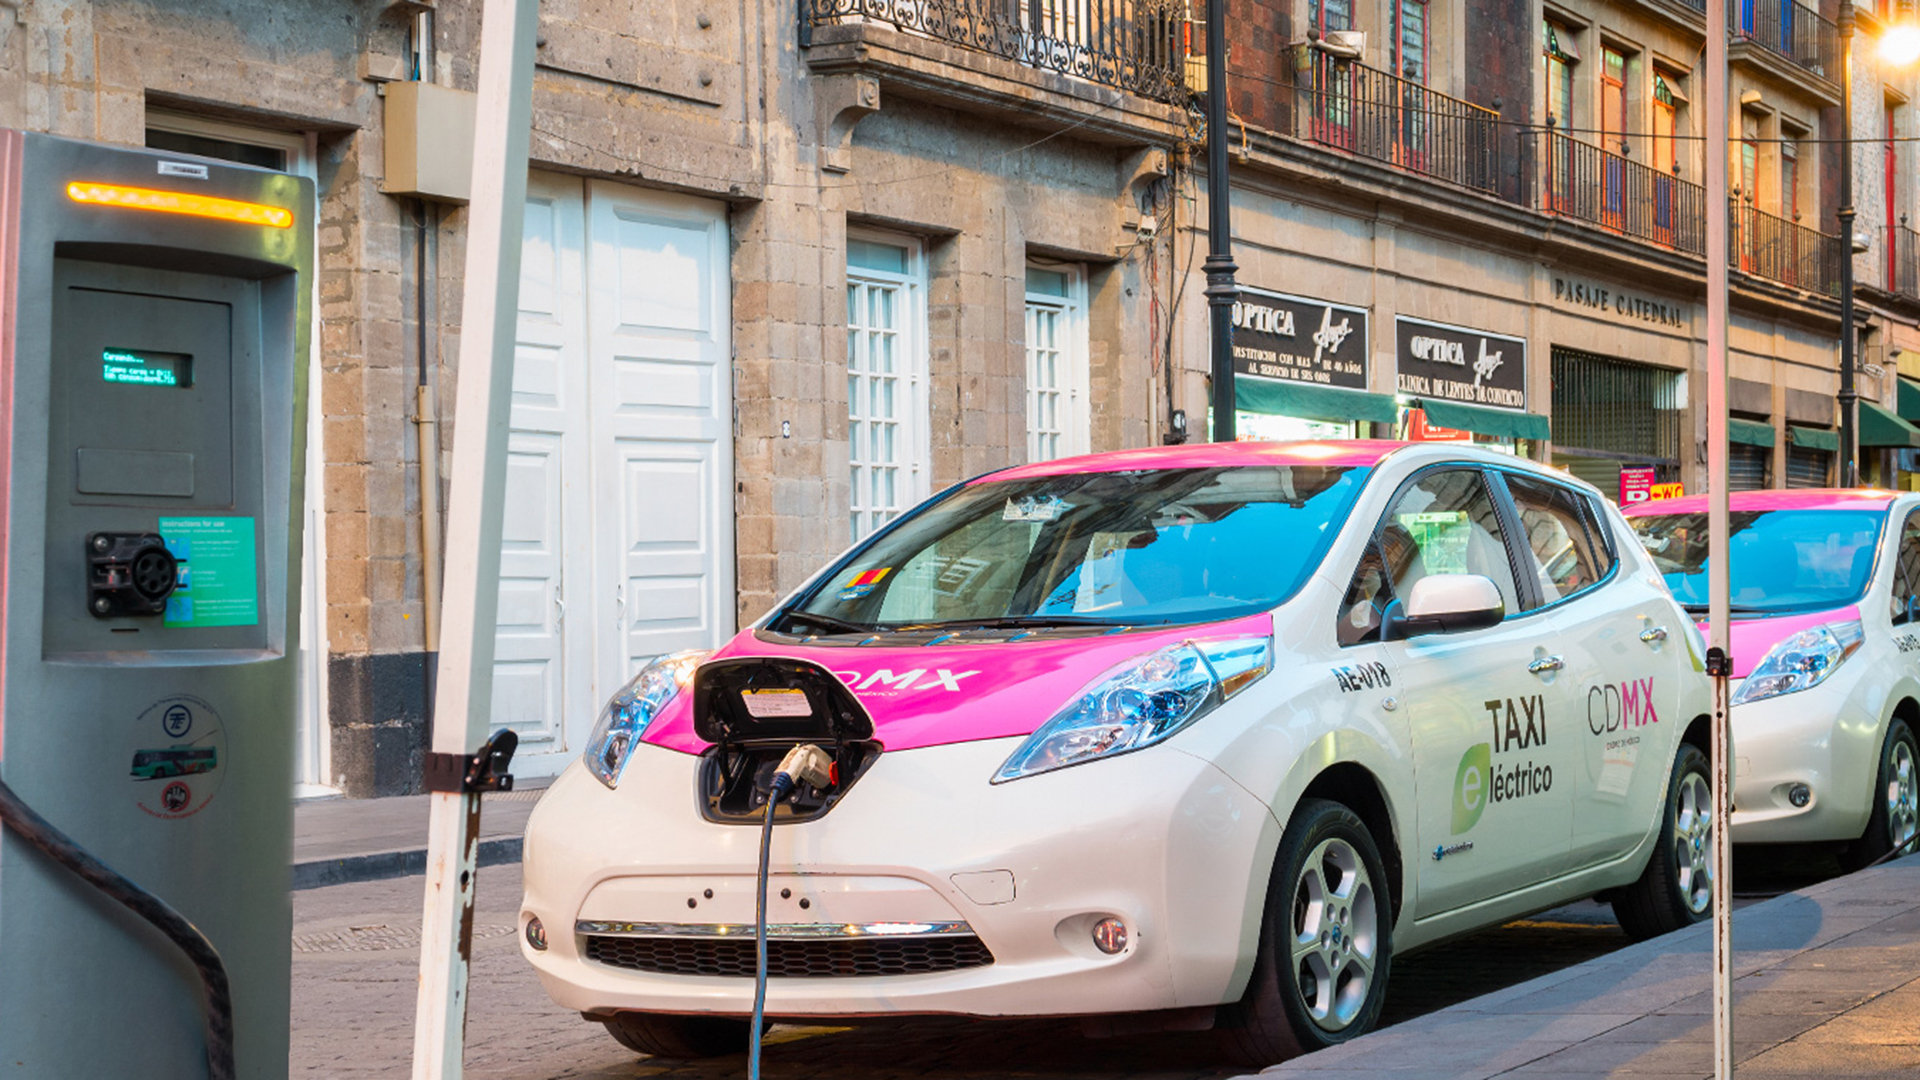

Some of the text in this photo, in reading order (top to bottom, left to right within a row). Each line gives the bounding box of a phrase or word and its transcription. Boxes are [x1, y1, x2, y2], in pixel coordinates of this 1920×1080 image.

[1232, 300, 1296, 337] OPTICA
[1555, 278, 1682, 328] PASAJE CATEDRAL
[1248, 362, 1258, 374] AL
[1411, 335, 1465, 366] OPTICA
[1398, 374, 1431, 395] CLINICA
[1433, 378, 1444, 397] DE
[1445, 381, 1475, 400] LENTES
[1487, 387, 1524, 407] CONTACTO
[1331, 661, 1391, 692] AE-018
[1485, 694, 1546, 753] TAXI
[1587, 676, 1659, 736] CDMX
